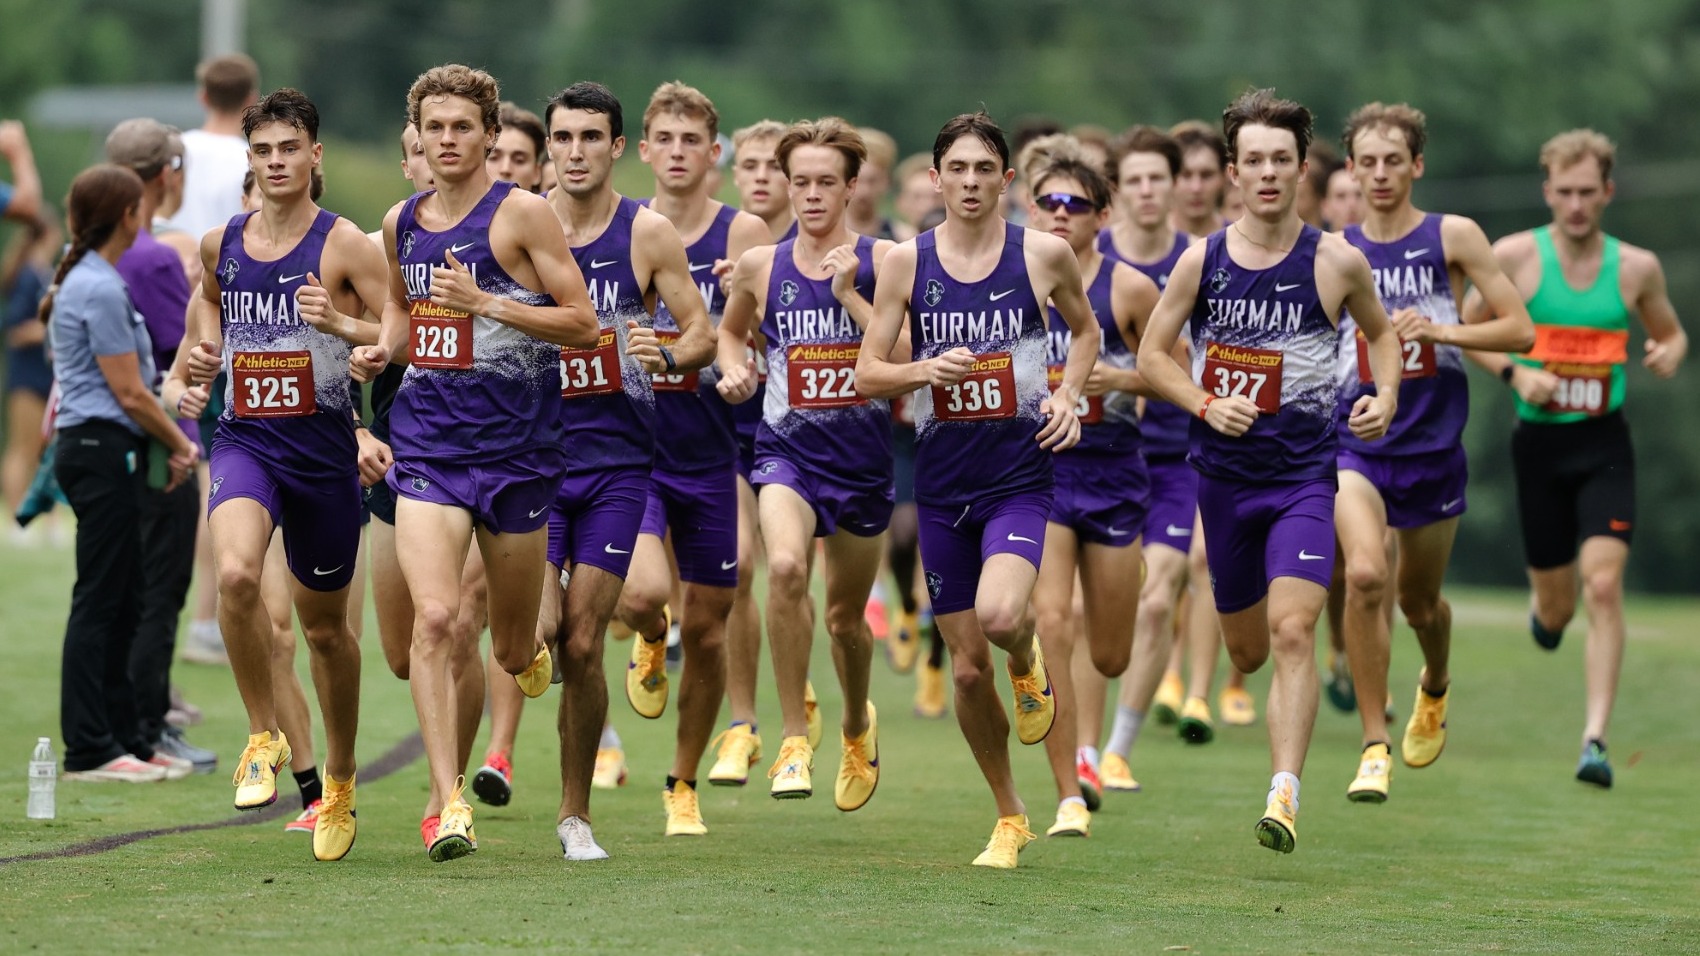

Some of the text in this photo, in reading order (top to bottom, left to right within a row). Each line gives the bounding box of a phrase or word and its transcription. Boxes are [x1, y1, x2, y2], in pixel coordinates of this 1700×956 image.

[775, 307, 860, 341] FURMA
[920, 308, 1023, 343] FURMAN
[1207, 298, 1303, 333] FURMAN
[415, 325, 458, 359] 328
[244, 376, 300, 409] 325
[800, 367, 857, 399] 322
[945, 378, 1002, 412] 336
[1214, 367, 1267, 402] 327
